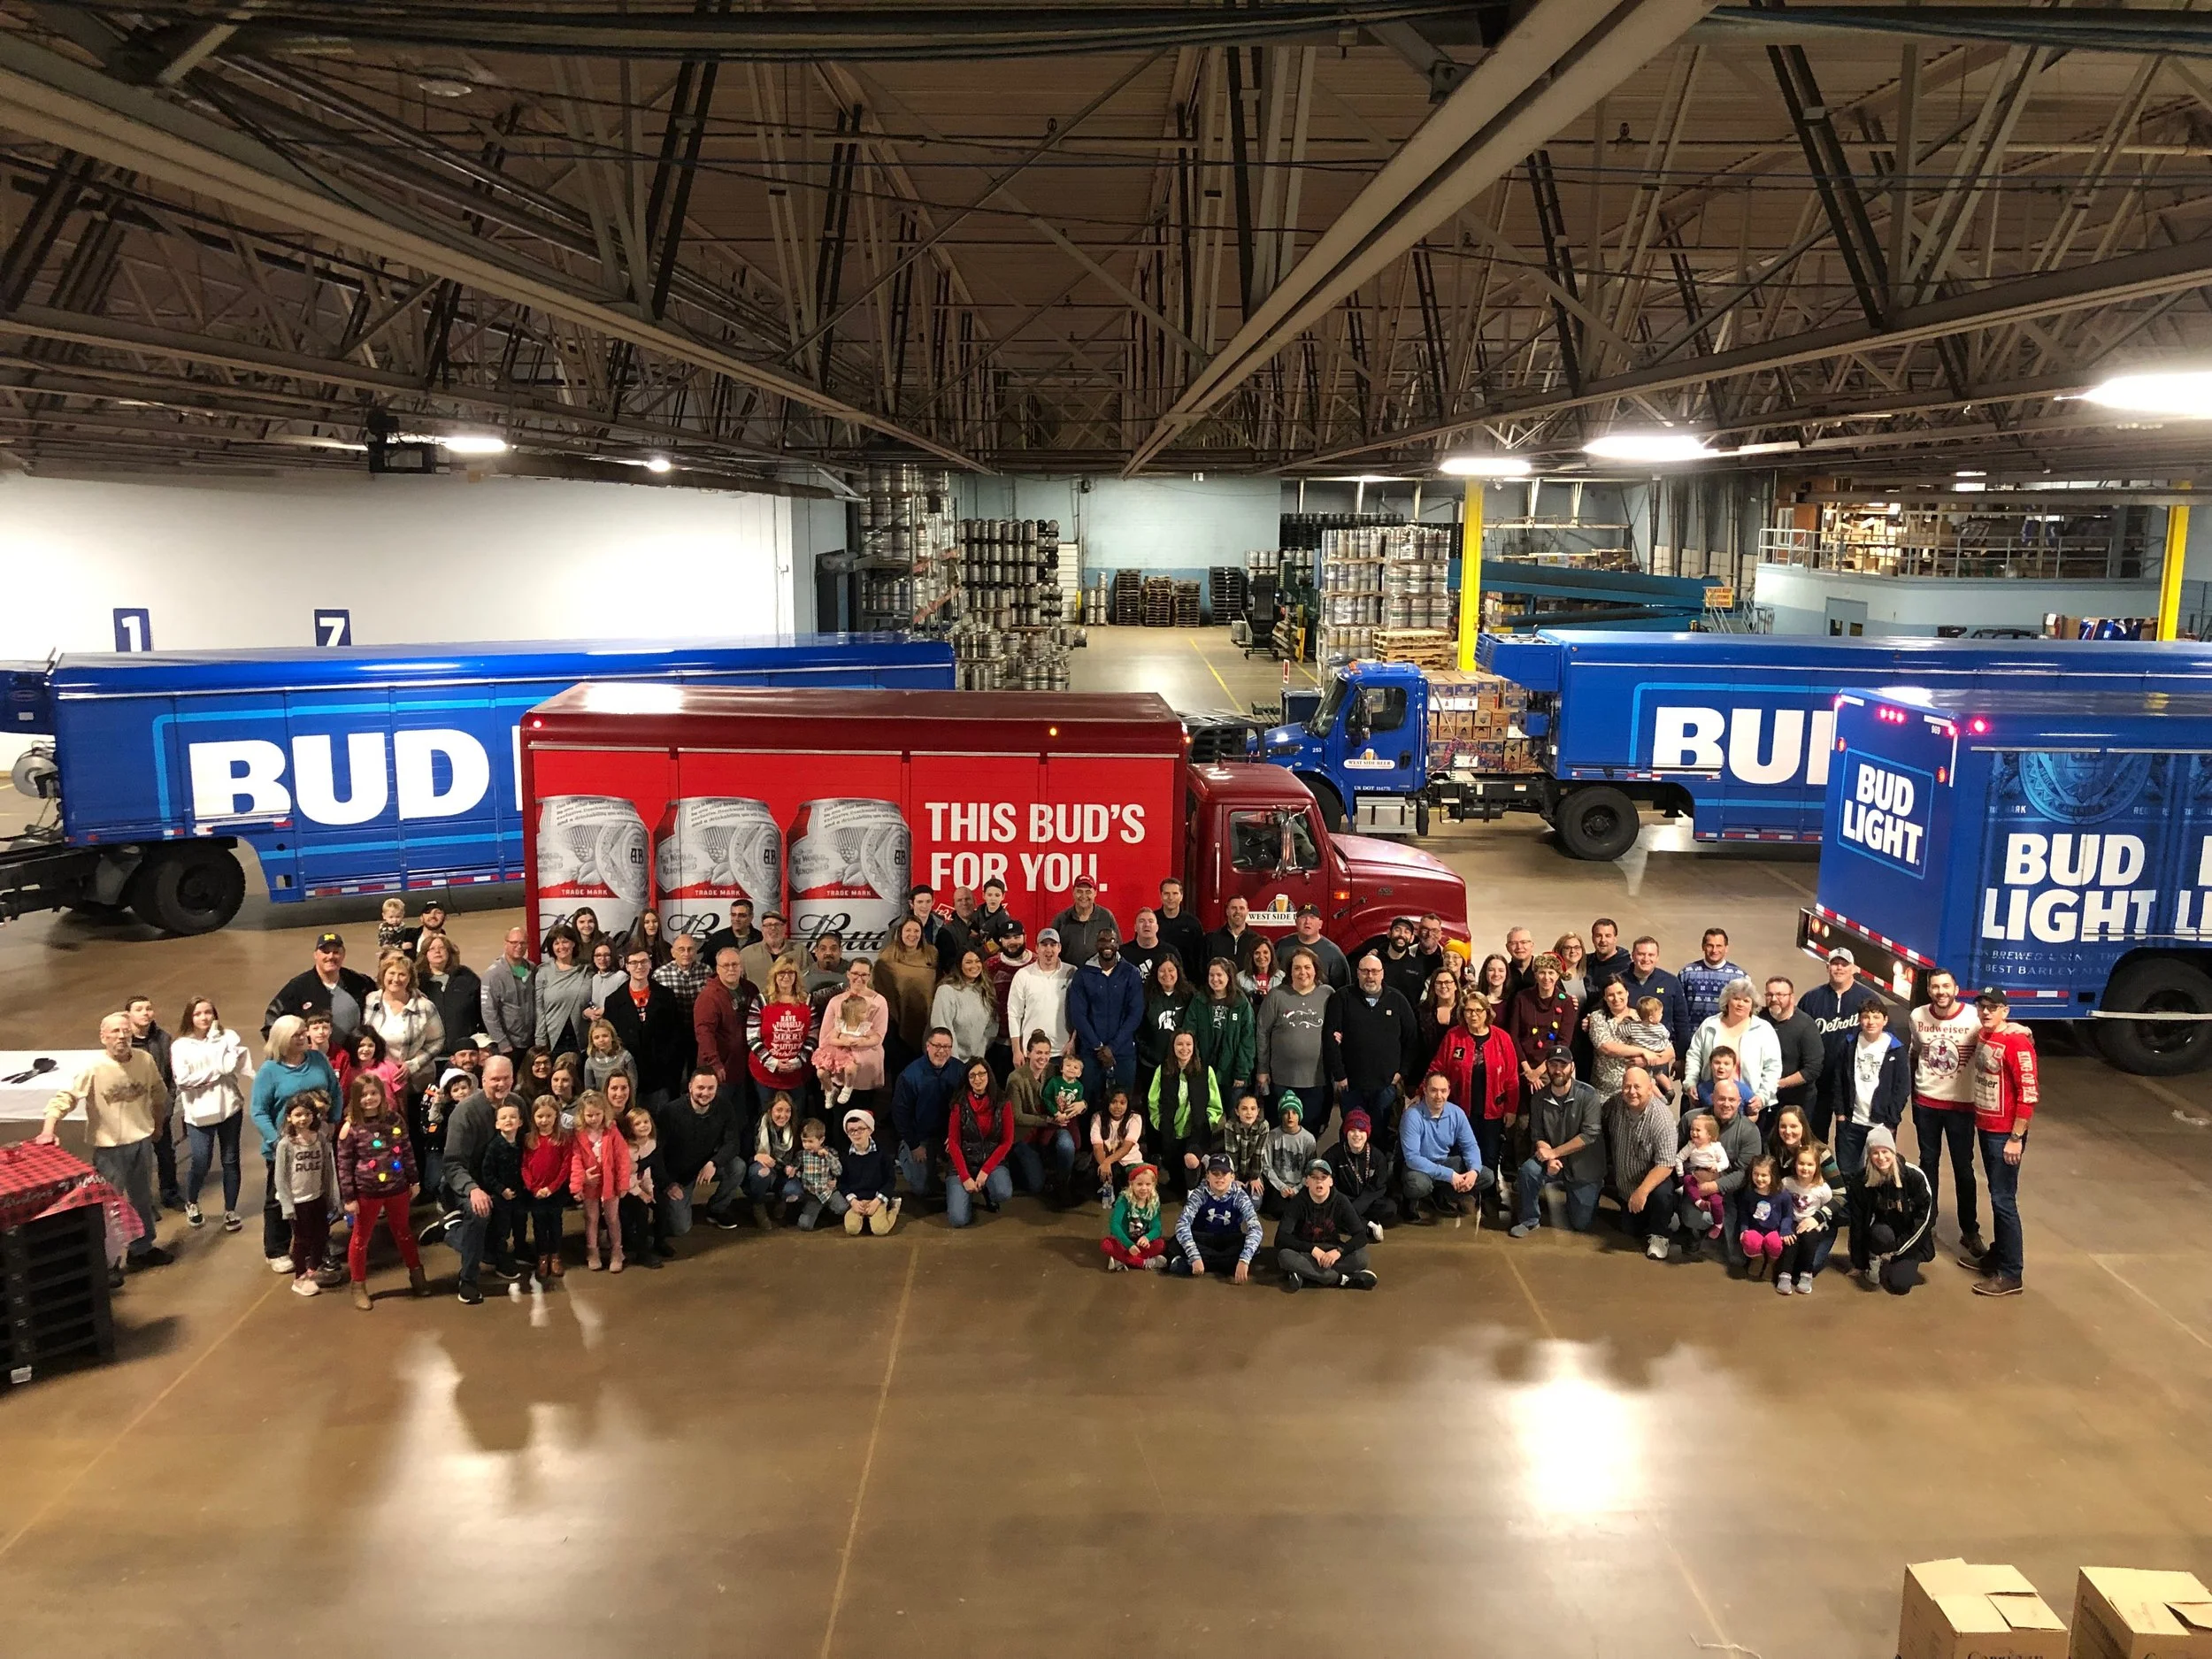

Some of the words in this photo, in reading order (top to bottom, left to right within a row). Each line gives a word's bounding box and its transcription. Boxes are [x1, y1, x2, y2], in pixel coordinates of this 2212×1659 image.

[120, 615, 142, 651] 1
[317, 617, 346, 648] 7
[188, 728, 490, 826] BUD
[1855, 764, 1915, 818] BUD
[925, 802, 1017, 843] THIS
[1027, 803, 1146, 844] BUD'S
[1842, 802, 1924, 865] LIGHT
[930, 852, 1009, 892] FOR
[1020, 853, 1108, 893] YOU.
[2003, 833, 2147, 887] BUD
[1980, 887, 2157, 942] LIGHT
[1985, 964, 2014, 974] BEST
[2017, 965, 2077, 976] BARLEY
[1991, 949, 2047, 962] BREWED
[1232, 1012, 1238, 1021] S
[1815, 1012, 1860, 1034] Detroit
[1917, 1021, 1970, 1034] Budweiser
[2021, 1072, 2035, 1085] OF
[296, 1161, 321, 1172] RULE
